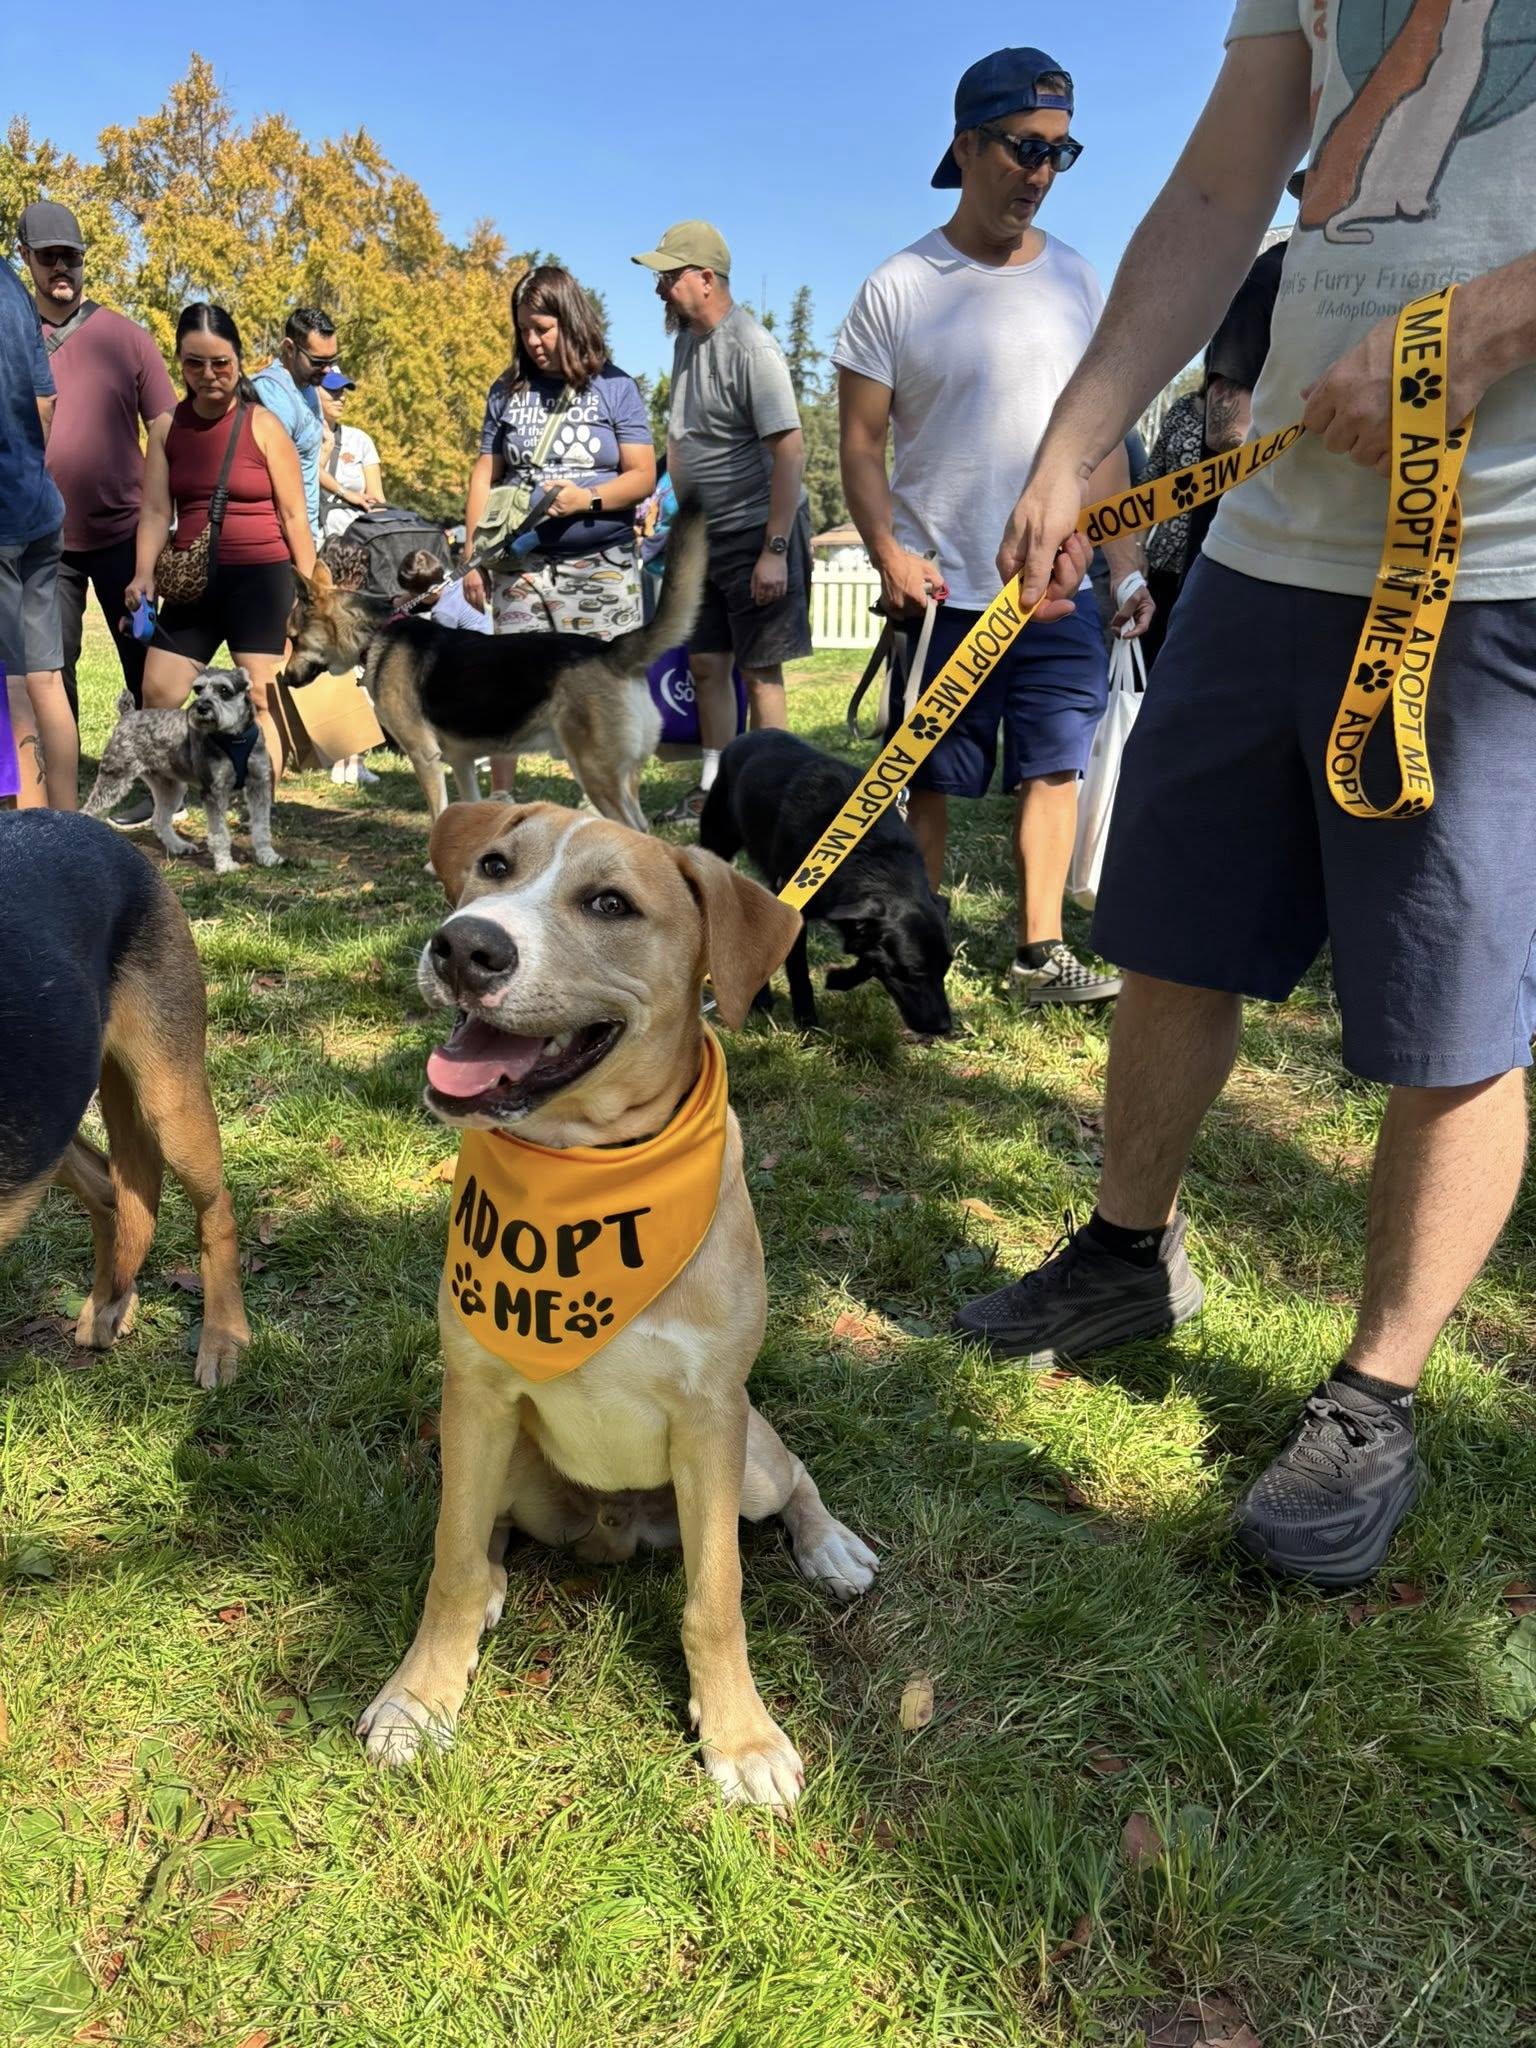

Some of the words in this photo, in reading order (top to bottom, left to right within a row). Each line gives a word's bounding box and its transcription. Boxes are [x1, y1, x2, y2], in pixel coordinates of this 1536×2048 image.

[1314, 269, 1366, 297] Furry
[1376, 266, 1470, 291] Friends
[1402, 308, 1444, 364] ME
[508, 406, 548, 425] THIS
[561, 406, 599, 423] OG
[509, 391, 530, 408] All
[587, 392, 600, 406] is
[507, 442, 534, 466] Do
[1203, 453, 1241, 497] ME
[1247, 424, 1306, 474] OPT
[1085, 487, 1155, 542] ADOP
[1392, 433, 1440, 557] ADOPT
[954, 596, 1021, 685] ADOPT
[1364, 604, 1412, 656] ME
[924, 677, 969, 721] ME
[1398, 626, 1435, 741] ADOPT
[1330, 708, 1372, 810] ADOPT
[1402, 744, 1431, 794] ME
[843, 743, 917, 829] ADOPT
[811, 827, 857, 865] ME
[455, 1174, 651, 1279] ADOPT
[494, 1280, 563, 1344] ME
